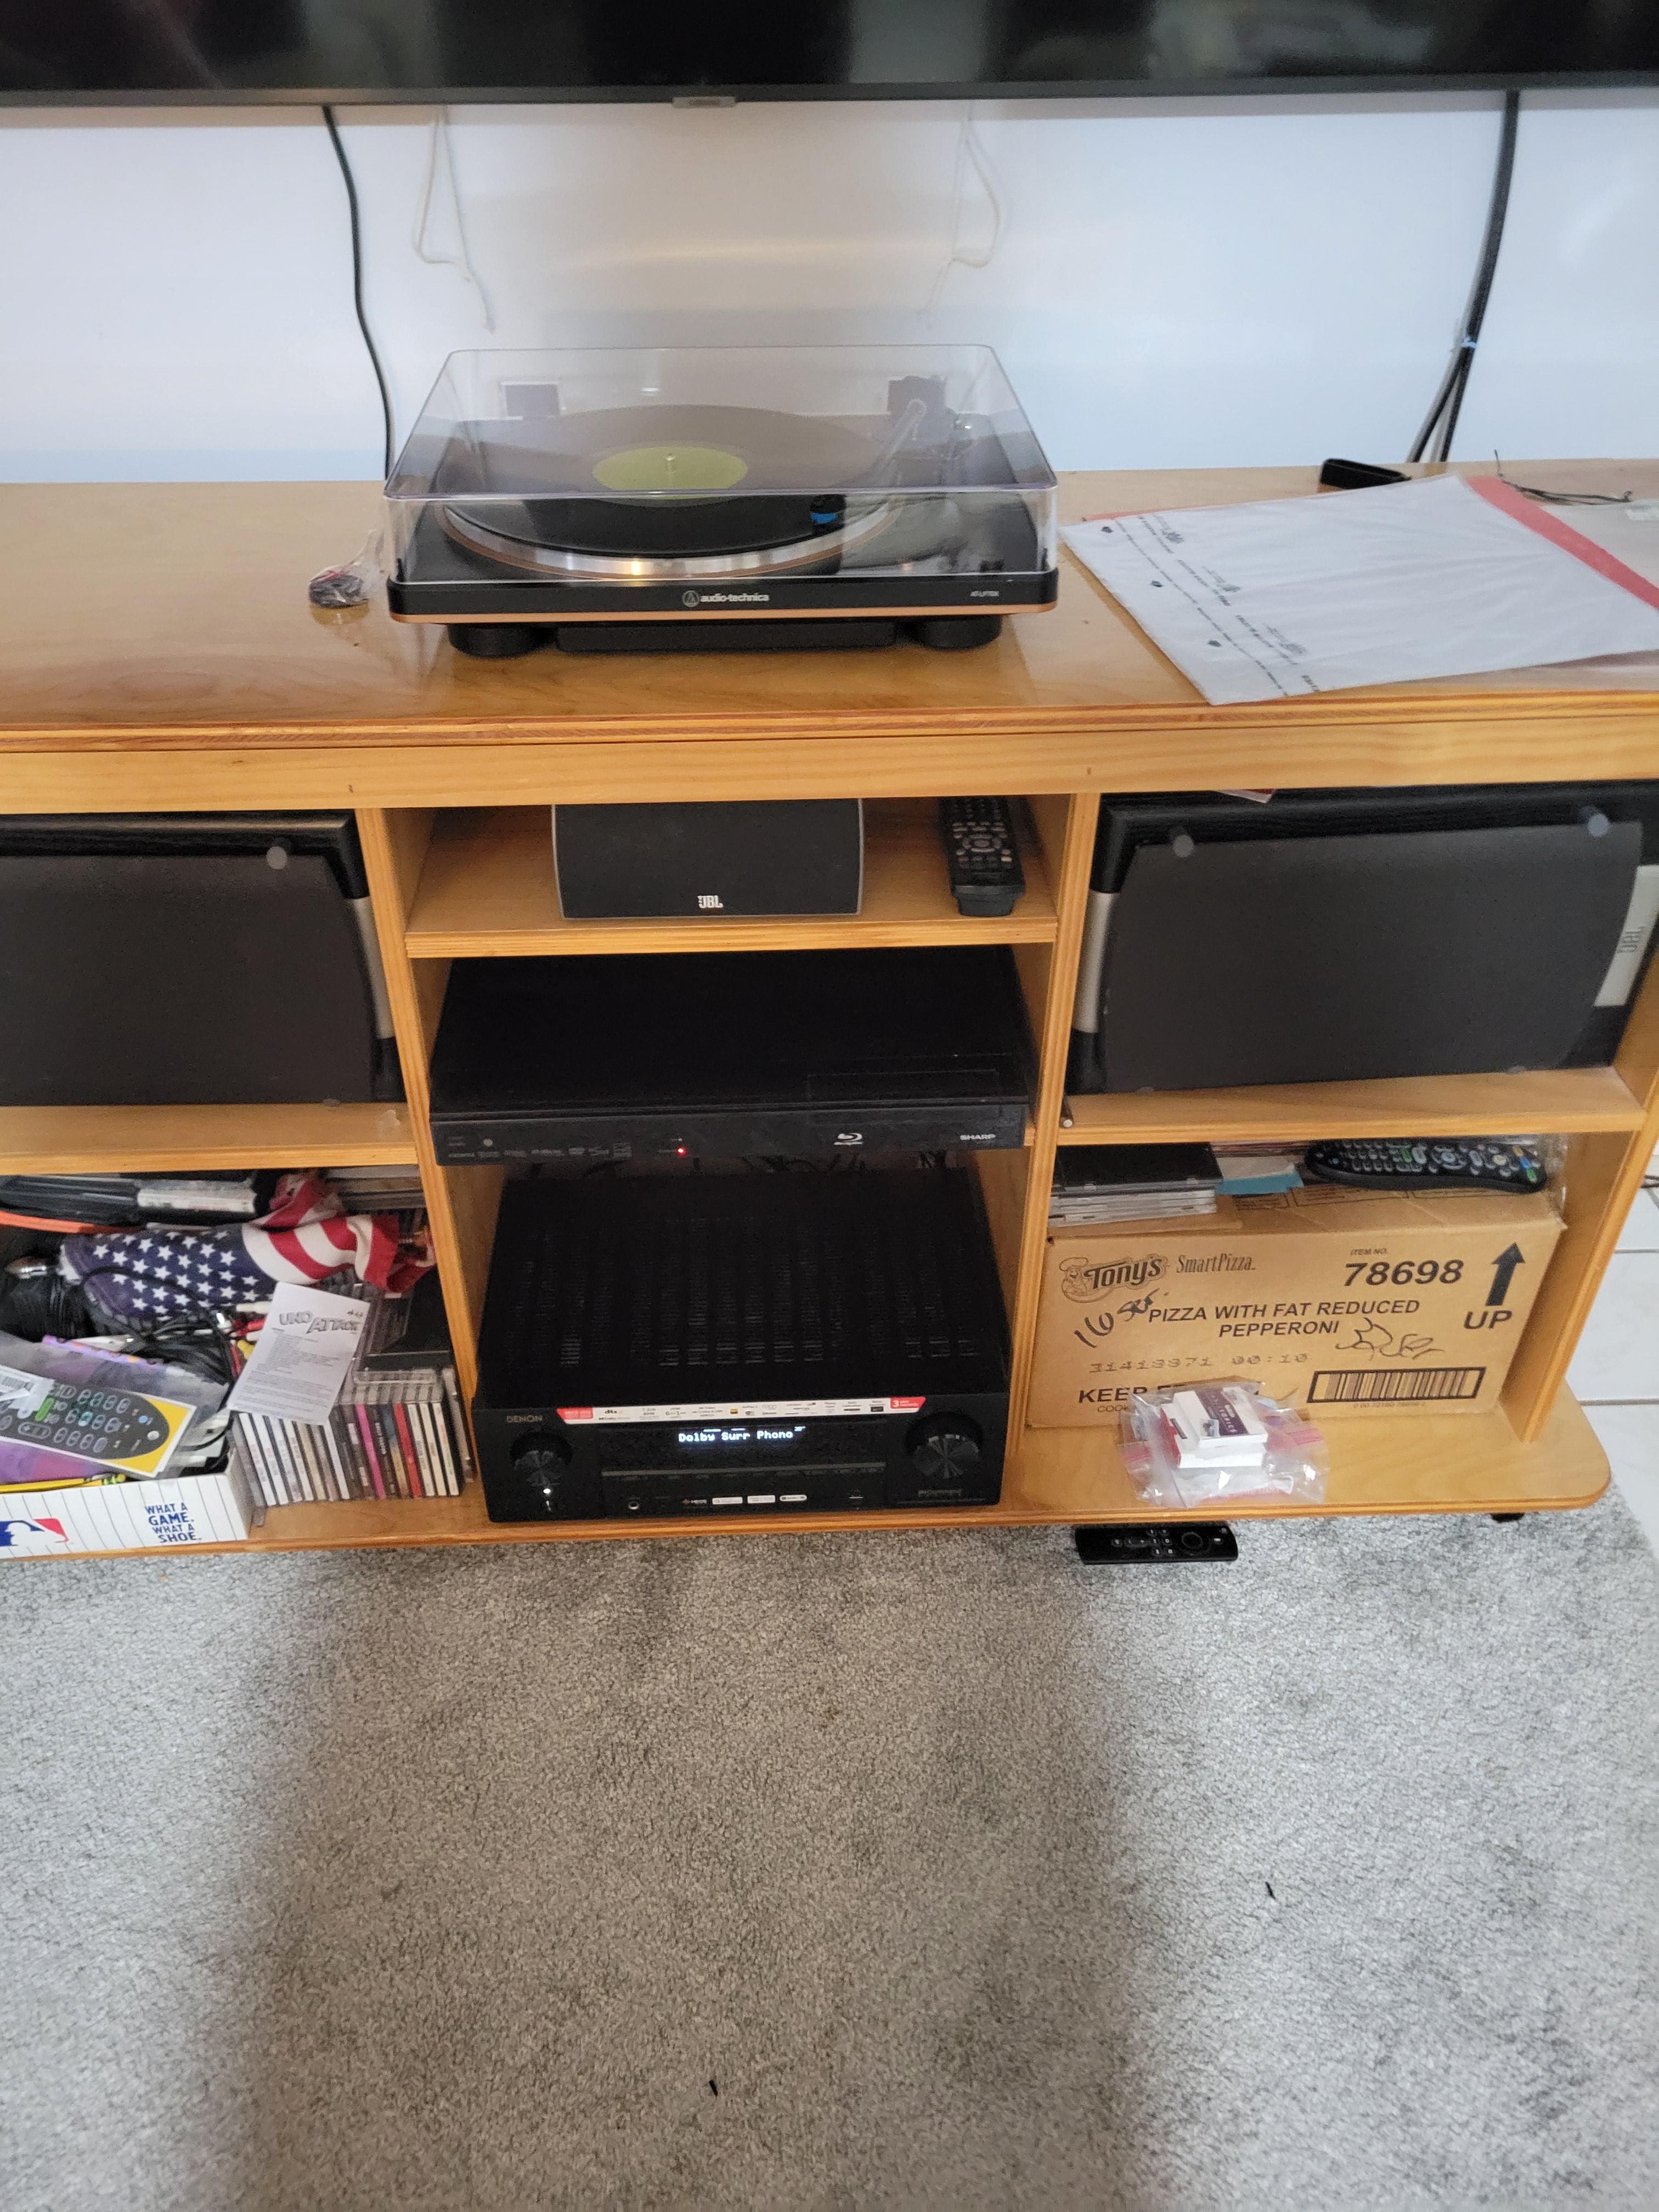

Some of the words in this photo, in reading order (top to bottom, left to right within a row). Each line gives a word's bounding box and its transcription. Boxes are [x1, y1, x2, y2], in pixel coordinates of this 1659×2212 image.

[700, 592, 769, 602] audio-technica
[697, 895, 723, 908] JBL
[1084, 1259, 1163, 1289] Tony's
[1344, 1260, 1464, 1286] 78698
[1149, 1307, 1207, 1323] PIZZA
[1215, 1304, 1267, 1319] WITH
[1273, 1302, 1311, 1317] FAT
[1317, 1300, 1420, 1316] REDUCED
[1464, 1310, 1513, 1329] UP
[1218, 1321, 1340, 1338] PEPPERONI
[678, 1432, 715, 1442] Dolby
[721, 1432, 751, 1441] Surr
[757, 1430, 793, 1440] Phono
[144, 1503, 175, 1514] WHAT
[181, 1502, 188, 1511] A
[148, 1512, 194, 1526] GAME.
[152, 1524, 183, 1534] WHAT
[158, 1532, 201, 1543] SHOE.
